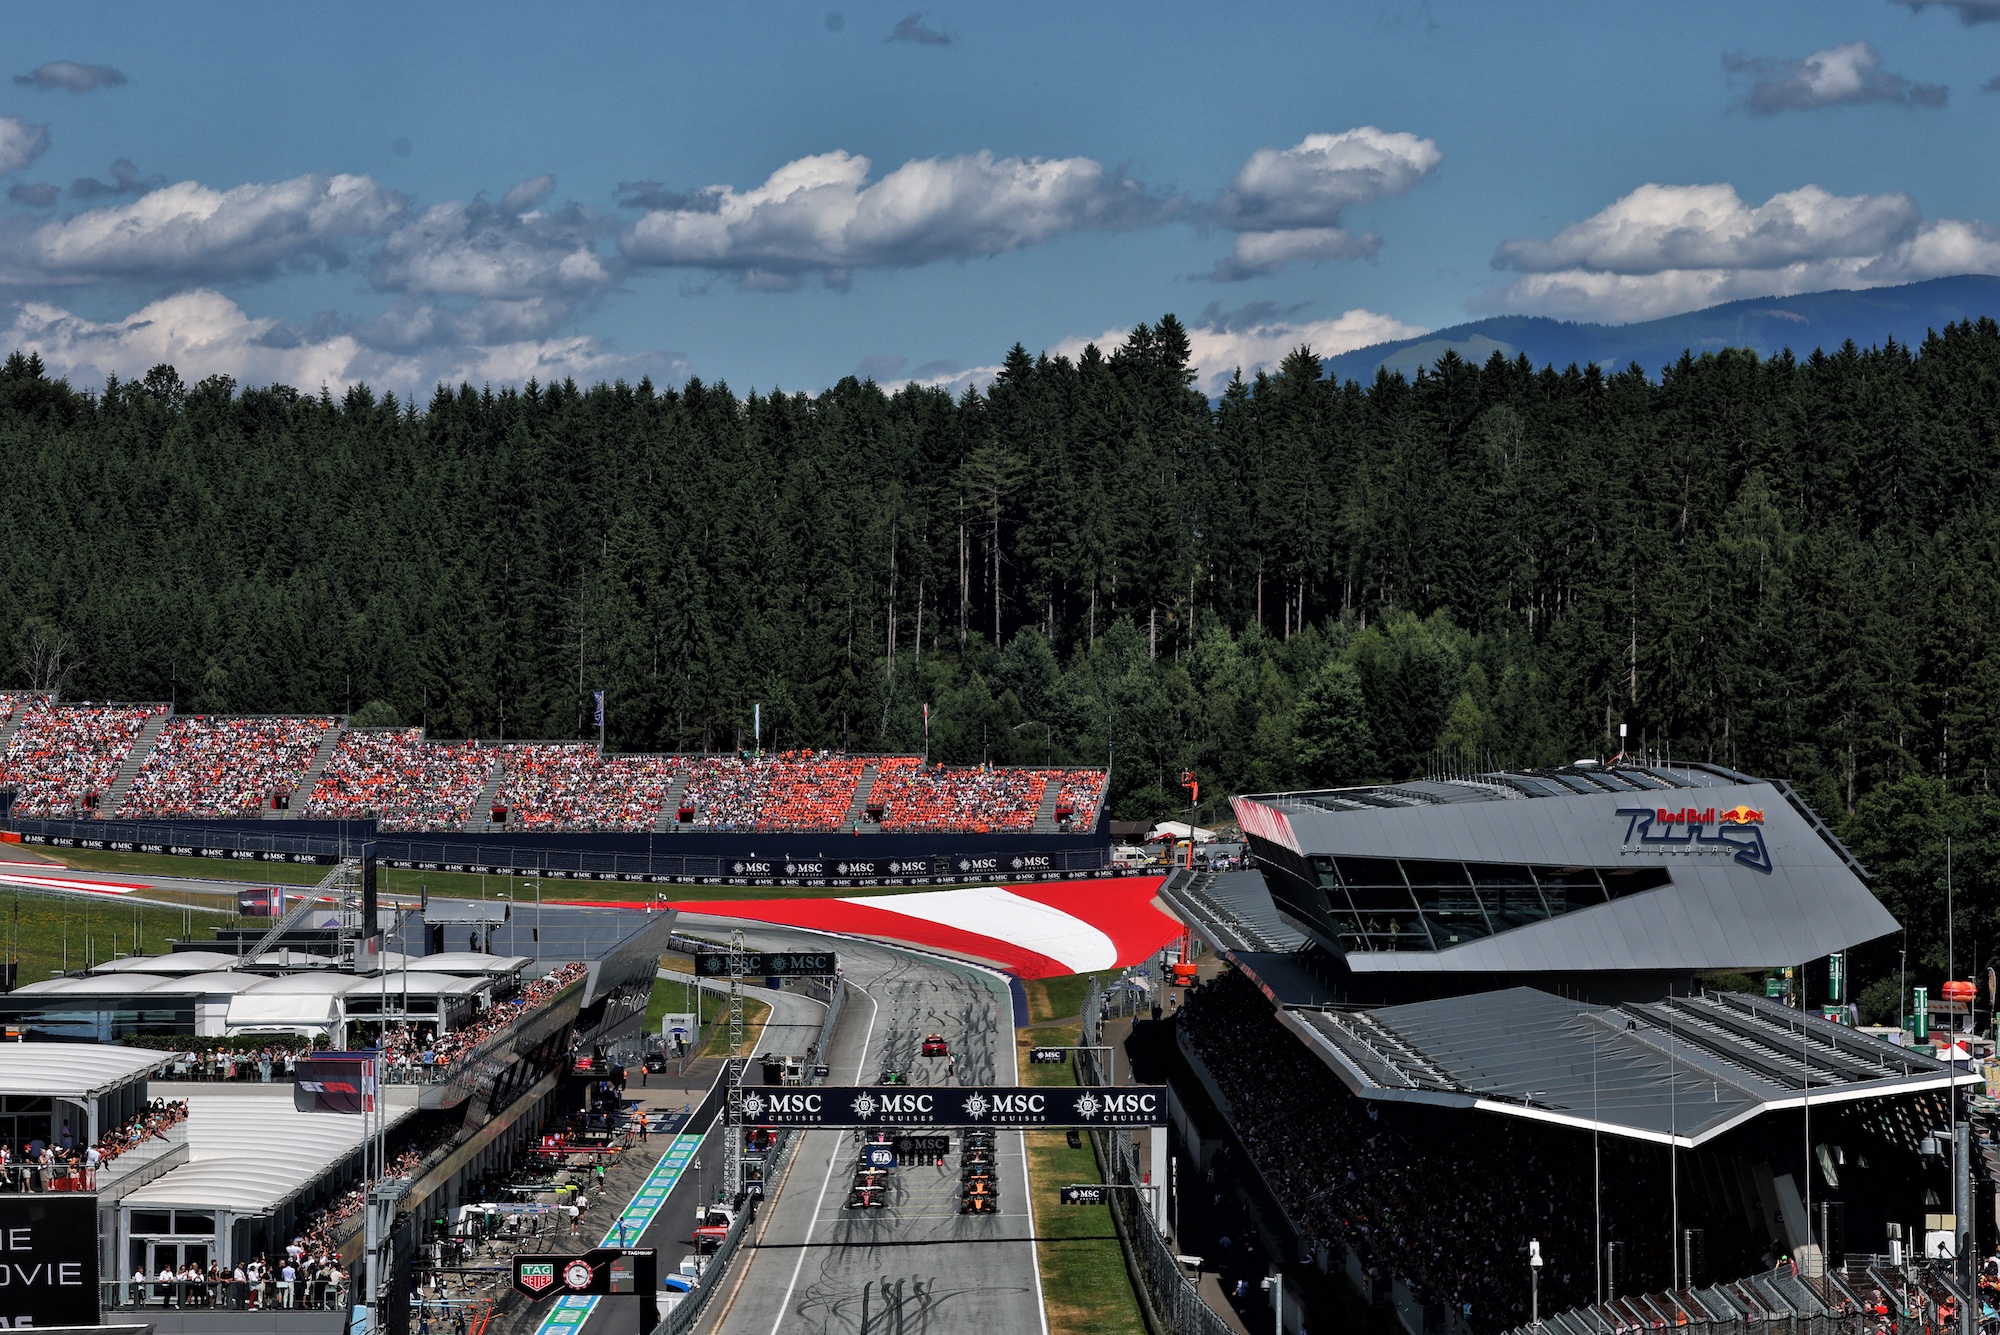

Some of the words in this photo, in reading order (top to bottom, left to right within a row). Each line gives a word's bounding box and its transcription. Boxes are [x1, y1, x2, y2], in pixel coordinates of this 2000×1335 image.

[1657, 808, 1685, 823] Red
[1687, 807, 1715, 823] Bull
[1621, 845, 1733, 853] SPIELBERG
[901, 861, 927, 871] MSC
[972, 859, 997, 869] MSC
[1024, 856, 1049, 866] MSC
[745, 862, 771, 872] MSC
[797, 863, 823, 873] MSC
[849, 863, 875, 873] MSC
[790, 956, 826, 969] MSC
[769, 1094, 822, 1113] MSC
[880, 1094, 933, 1113] MSC
[992, 1094, 1045, 1113] MSC
[1103, 1094, 1157, 1113] MSC
[915, 1139, 945, 1149] MSC
[1080, 1190, 1100, 1198] MSC
[524, 1266, 550, 1274] TAG
[522, 1275, 552, 1289] HEUER
